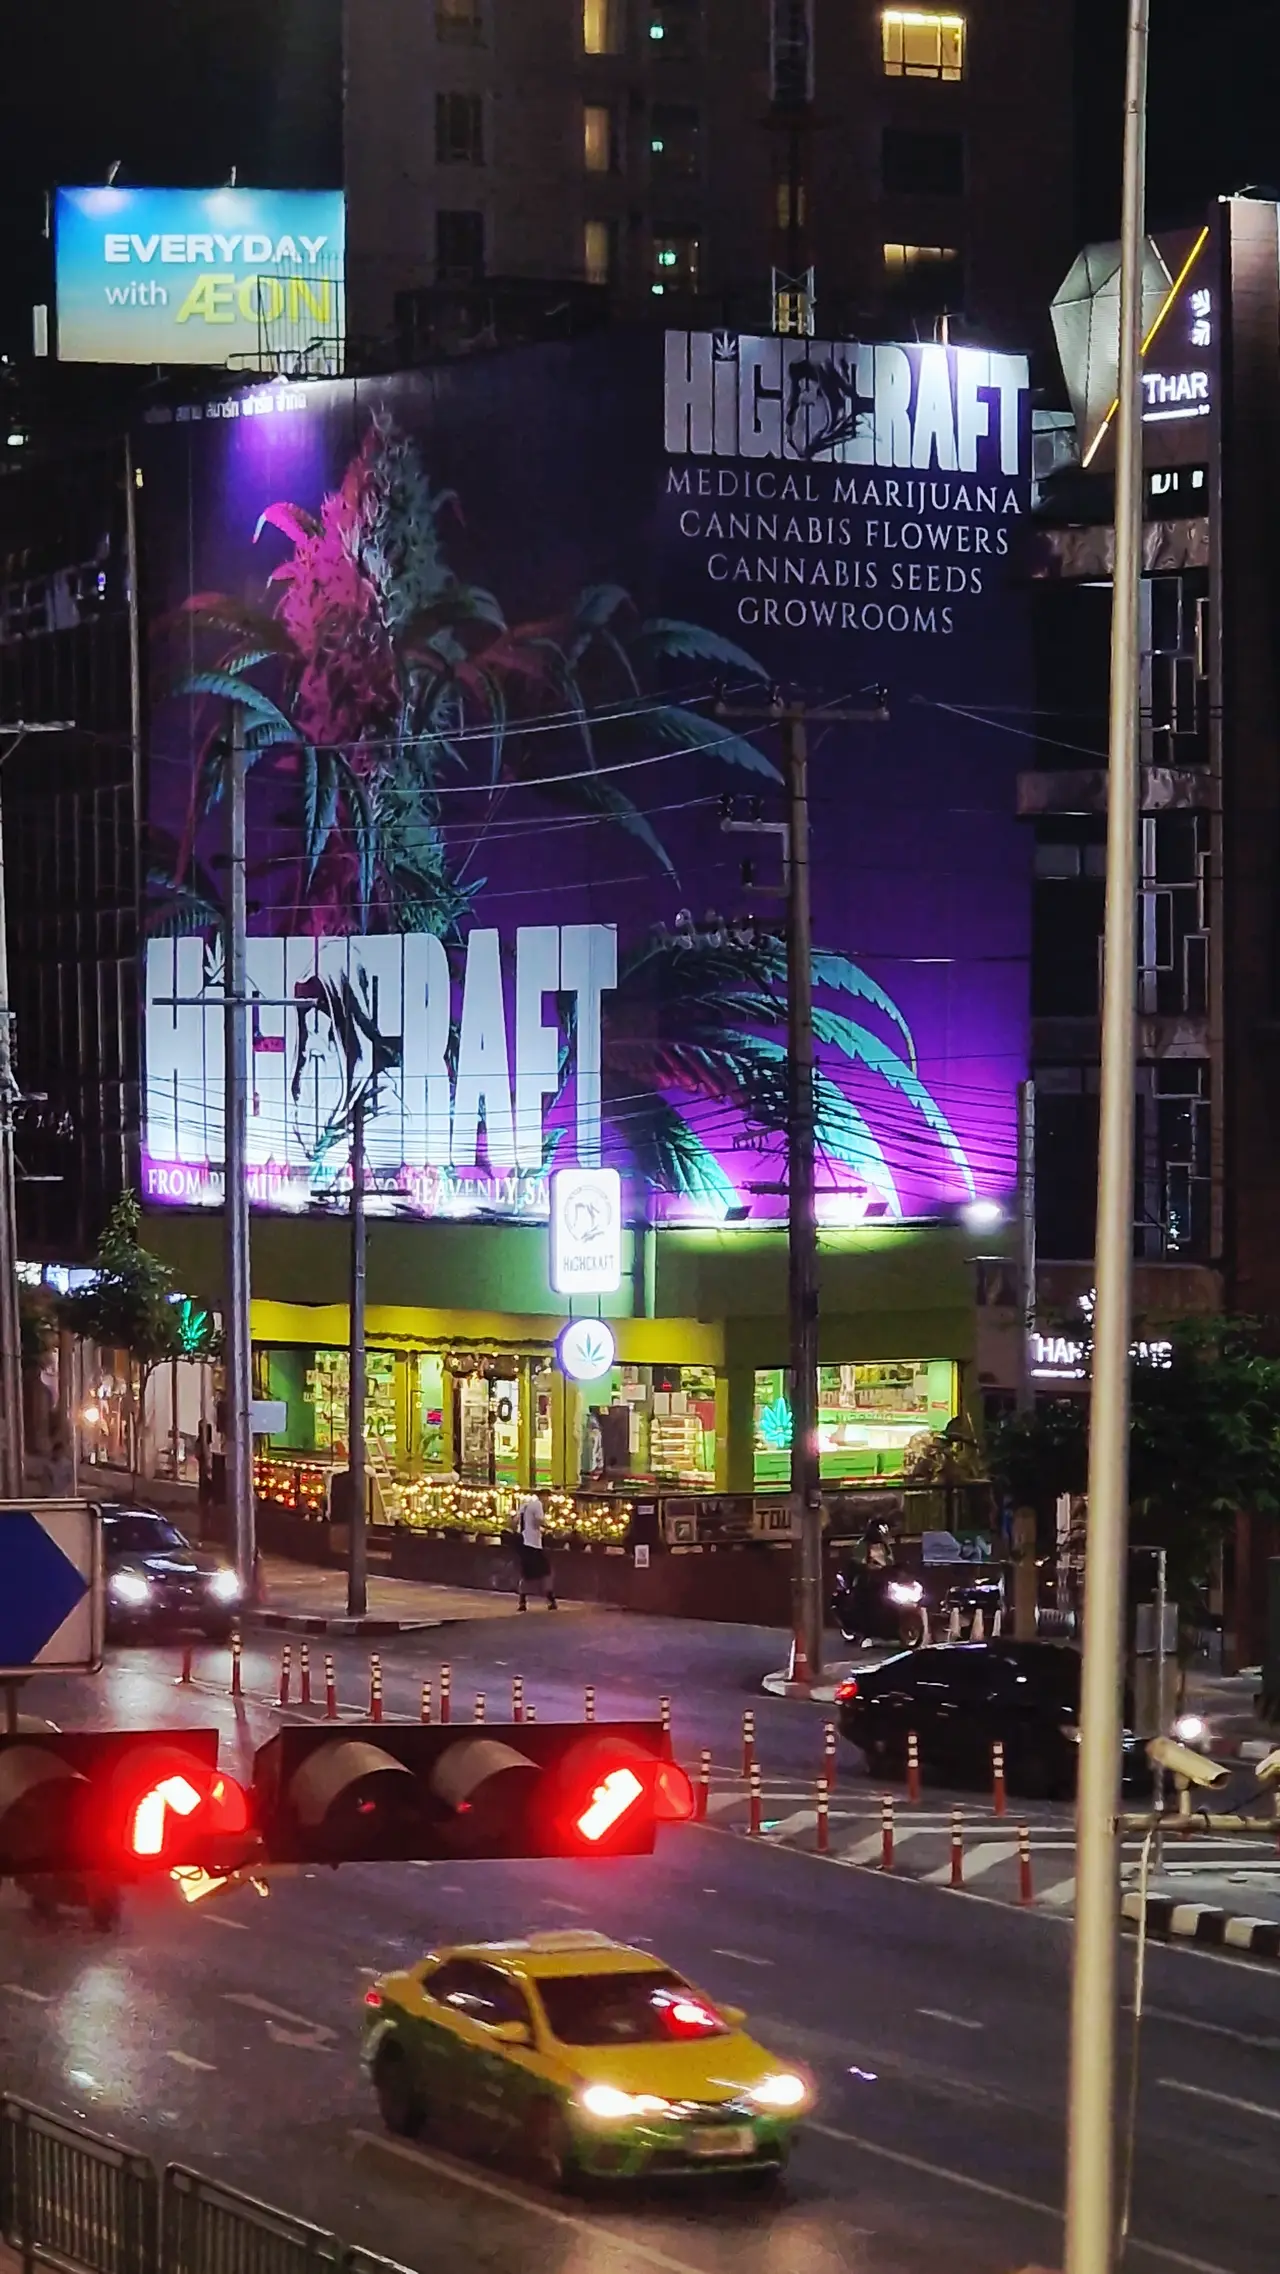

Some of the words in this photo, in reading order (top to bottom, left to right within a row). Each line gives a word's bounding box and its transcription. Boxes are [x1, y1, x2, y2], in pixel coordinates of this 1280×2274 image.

[104, 233, 328, 264] EVERYDAY
[104, 280, 168, 306] with
[665, 467, 820, 502] MEDICAL
[833, 476, 1023, 515] MARIJUANA
[679, 510, 852, 546] CANNABIS
[865, 519, 1009, 556] FLOWERS
[707, 552, 878, 589] CANNABIS
[890, 562, 983, 594] SEEDS
[737, 596, 954, 635] GROWROOMS
[147, 1168, 202, 1195] FROM
